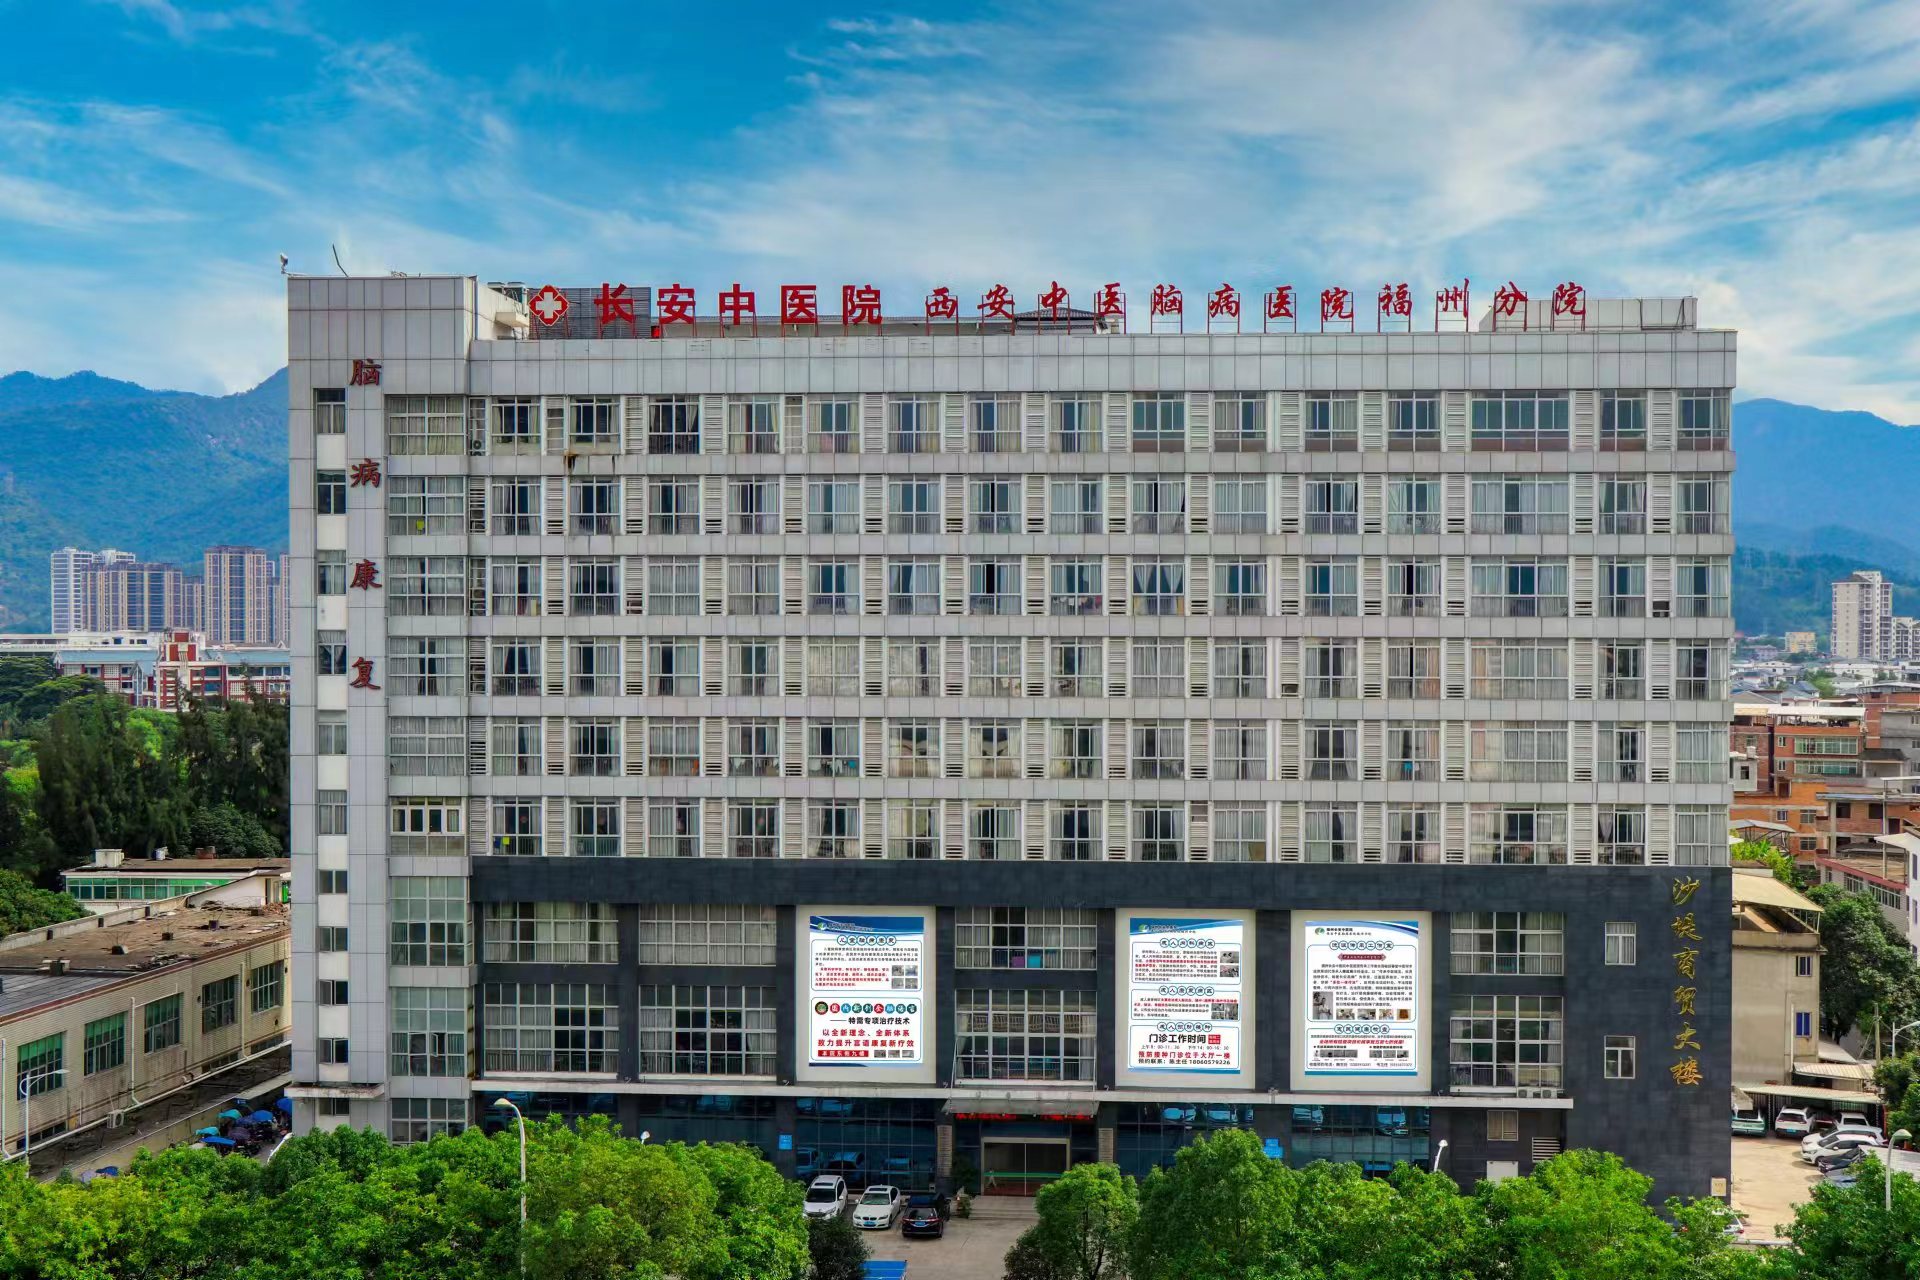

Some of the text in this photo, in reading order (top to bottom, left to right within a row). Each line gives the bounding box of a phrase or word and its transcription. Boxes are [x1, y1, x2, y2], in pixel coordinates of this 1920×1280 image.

[593, 283, 883, 325] 长安中医院
[926, 278, 1587, 324] 西安中医脑病医院福州分院
[349, 358, 383, 691] 脑病康复
[1149, 1034, 1206, 1043] 门诊工作时间
